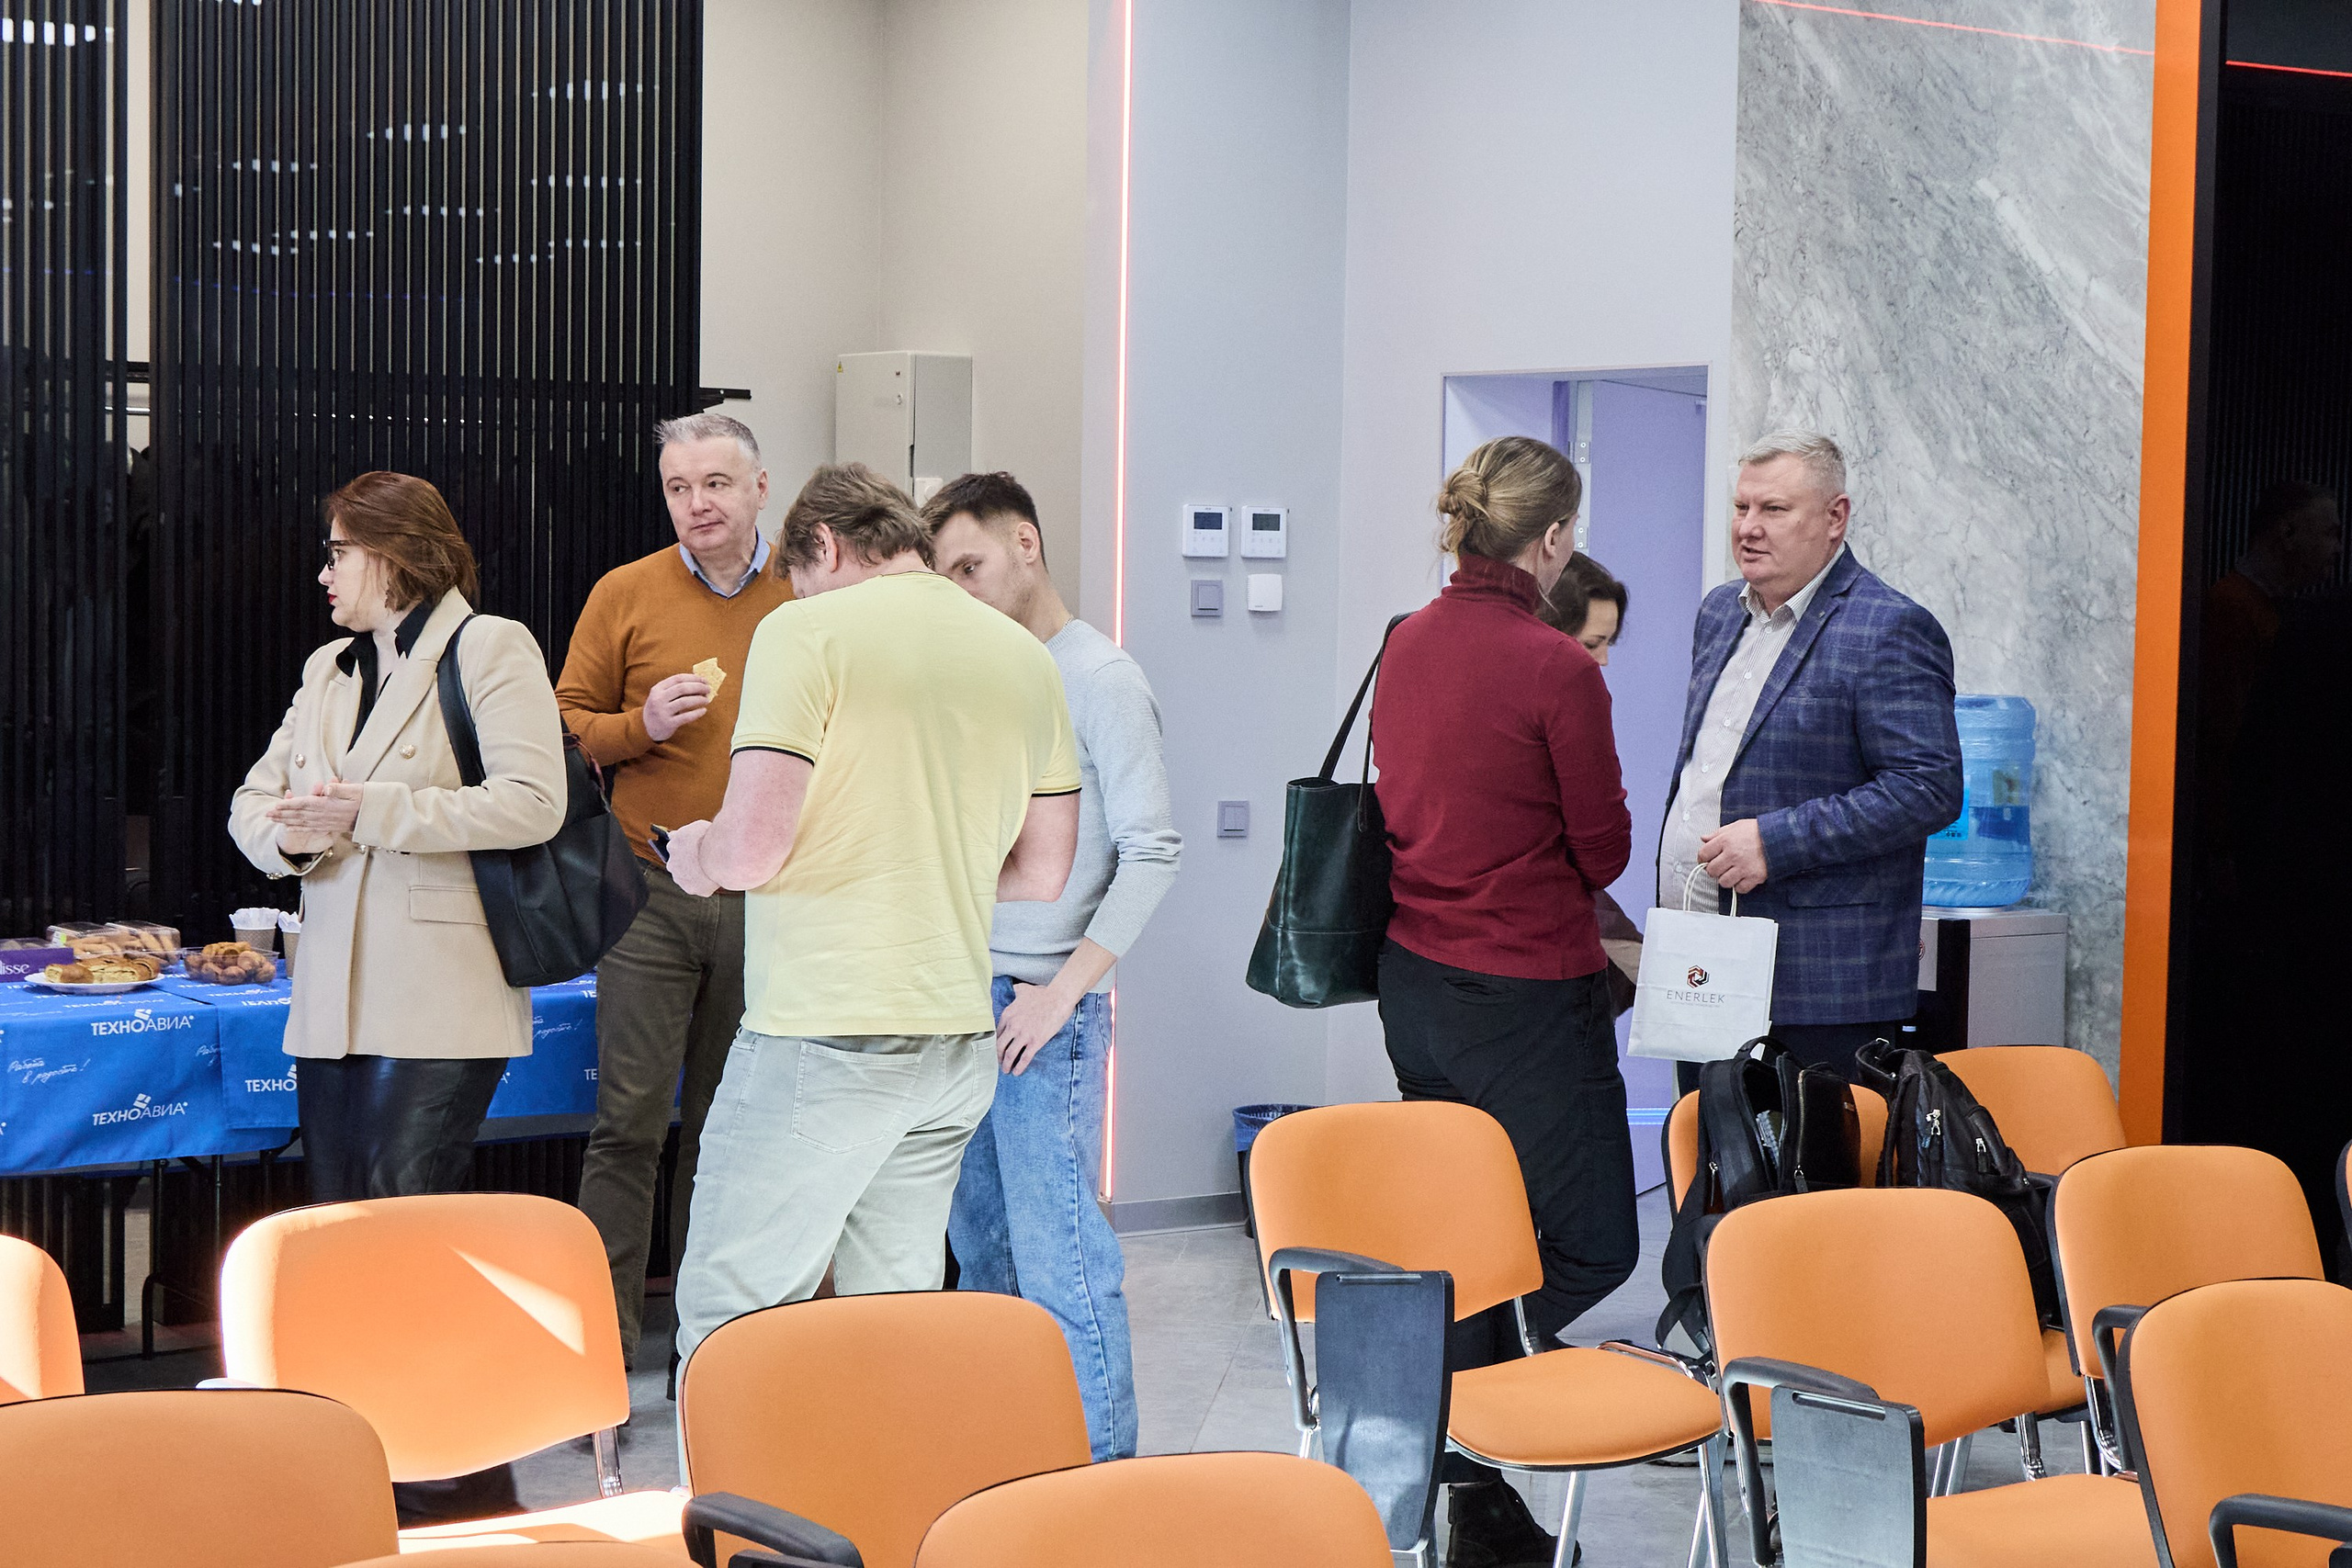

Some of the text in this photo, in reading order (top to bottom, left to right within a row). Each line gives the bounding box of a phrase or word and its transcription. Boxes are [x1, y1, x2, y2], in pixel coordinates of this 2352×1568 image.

[1667, 989, 1725, 1003] ENERLEK
[90, 1016, 191, 1036] ТЕХНОАВИА
[92, 1102, 186, 1126] ТЕХНОАВИА
